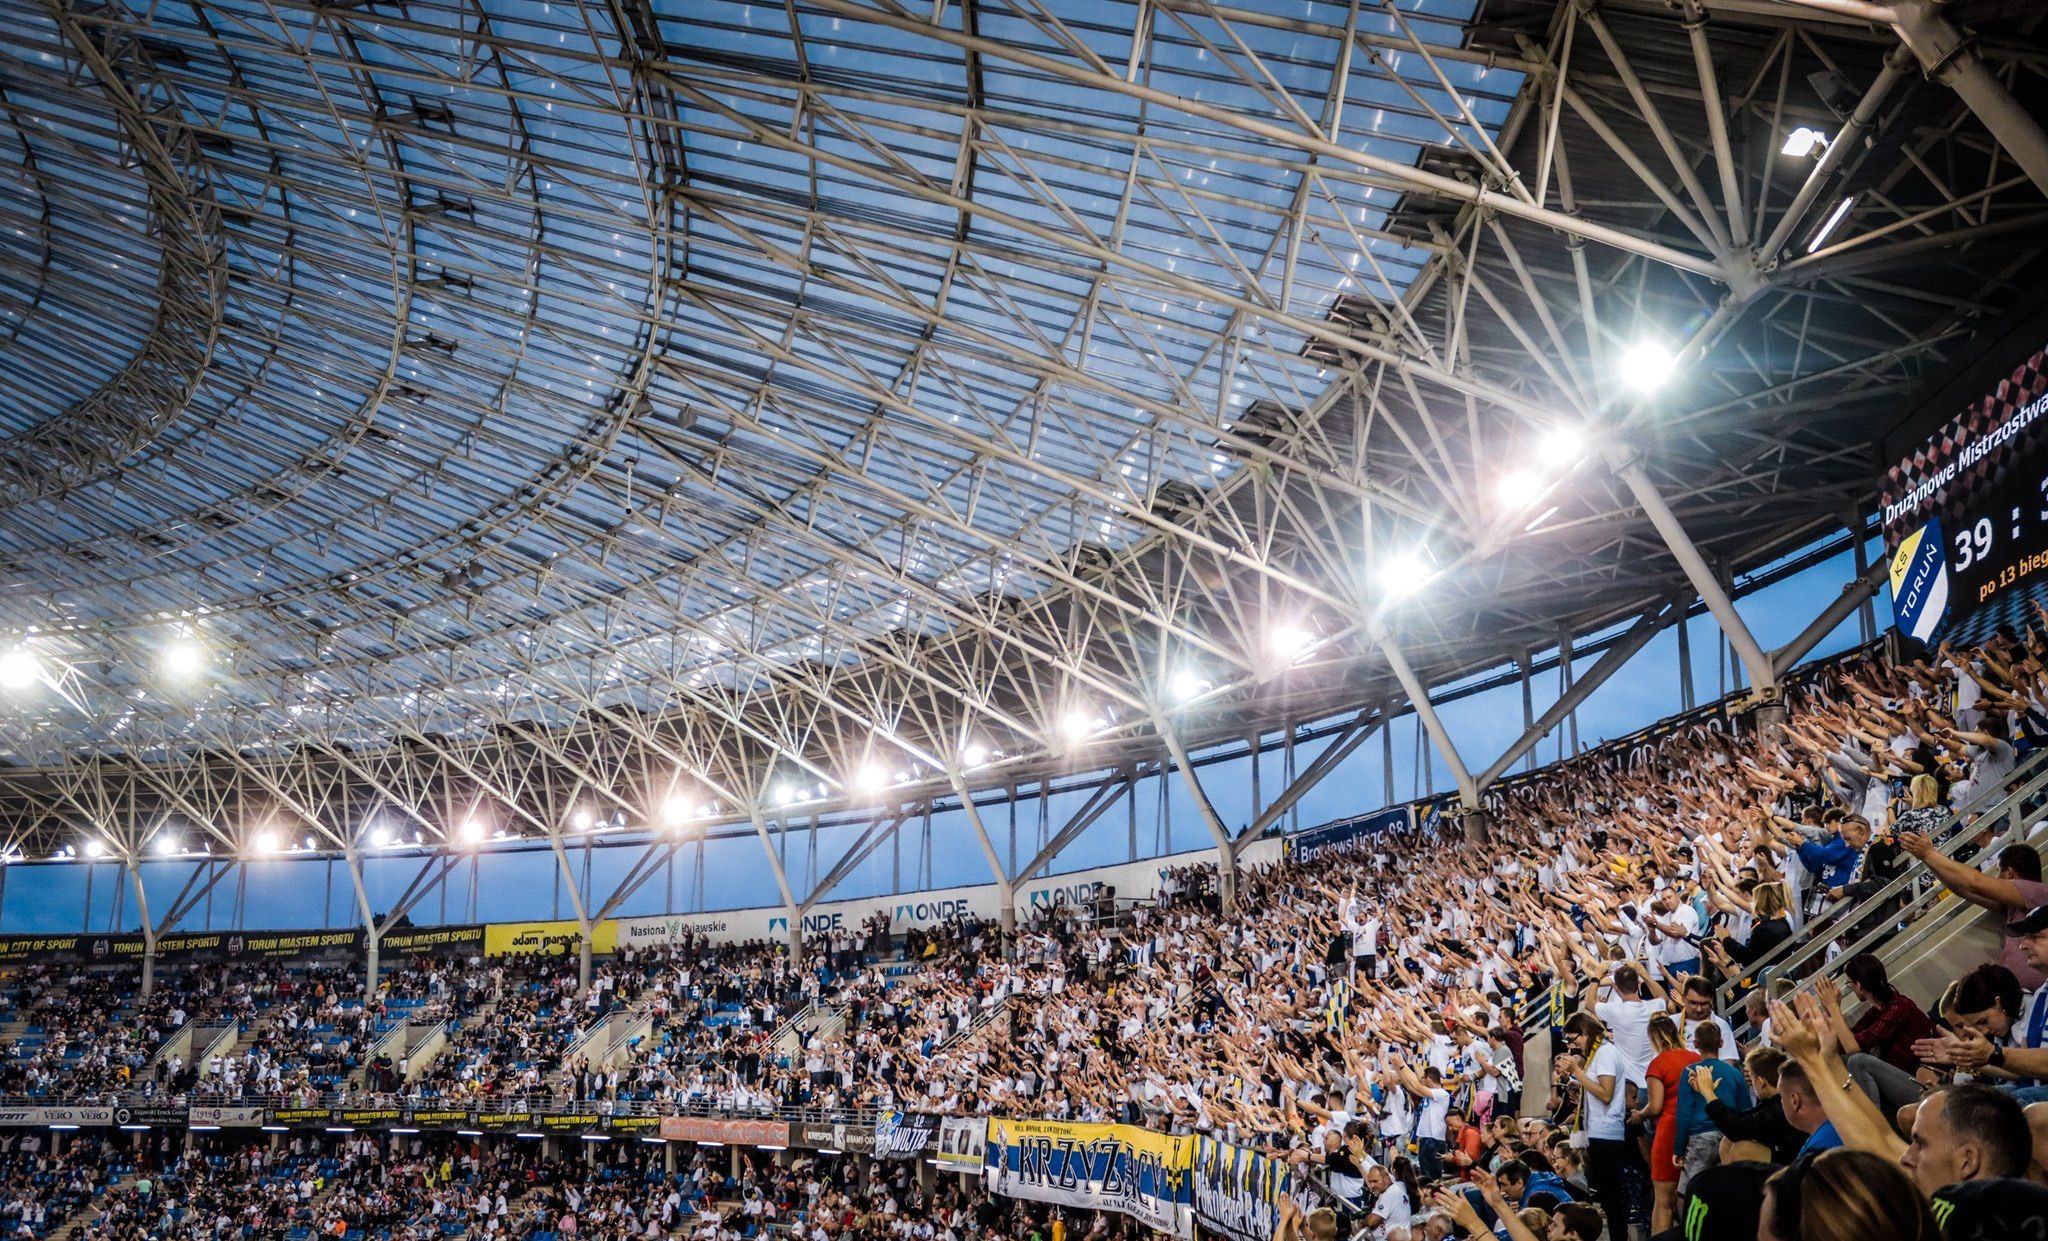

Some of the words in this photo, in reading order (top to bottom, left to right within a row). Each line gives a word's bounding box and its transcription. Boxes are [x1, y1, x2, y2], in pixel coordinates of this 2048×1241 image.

[1886, 462, 1956, 525] Drużynowe
[1955, 518, 1993, 573] 39
[1894, 551, 1908, 577] KS
[1901, 543, 1938, 618] TORUŃ
[1979, 580, 1996, 603] po
[1999, 563, 2016, 588] 13
[916, 899, 970, 921] ONDE
[631, 925, 666, 937] Nasiona
[801, 913, 844, 933] NDE
[11, 941, 32, 952] CITY
[33, 940, 46, 951] OF
[46, 938, 78, 950] SPORT
[186, 936, 221, 949] SPORTU
[279, 936, 319, 949] MIASTEM
[320, 933, 355, 946] SPORTU
[414, 931, 449, 946] MIASTEM
[450, 929, 482, 942] SPORTU
[512, 934, 539, 946] adam
[44, 1111, 73, 1120] VERO
[80, 1111, 109, 1120] VERO
[1018, 1134, 1163, 1214] KRZYŻACY
